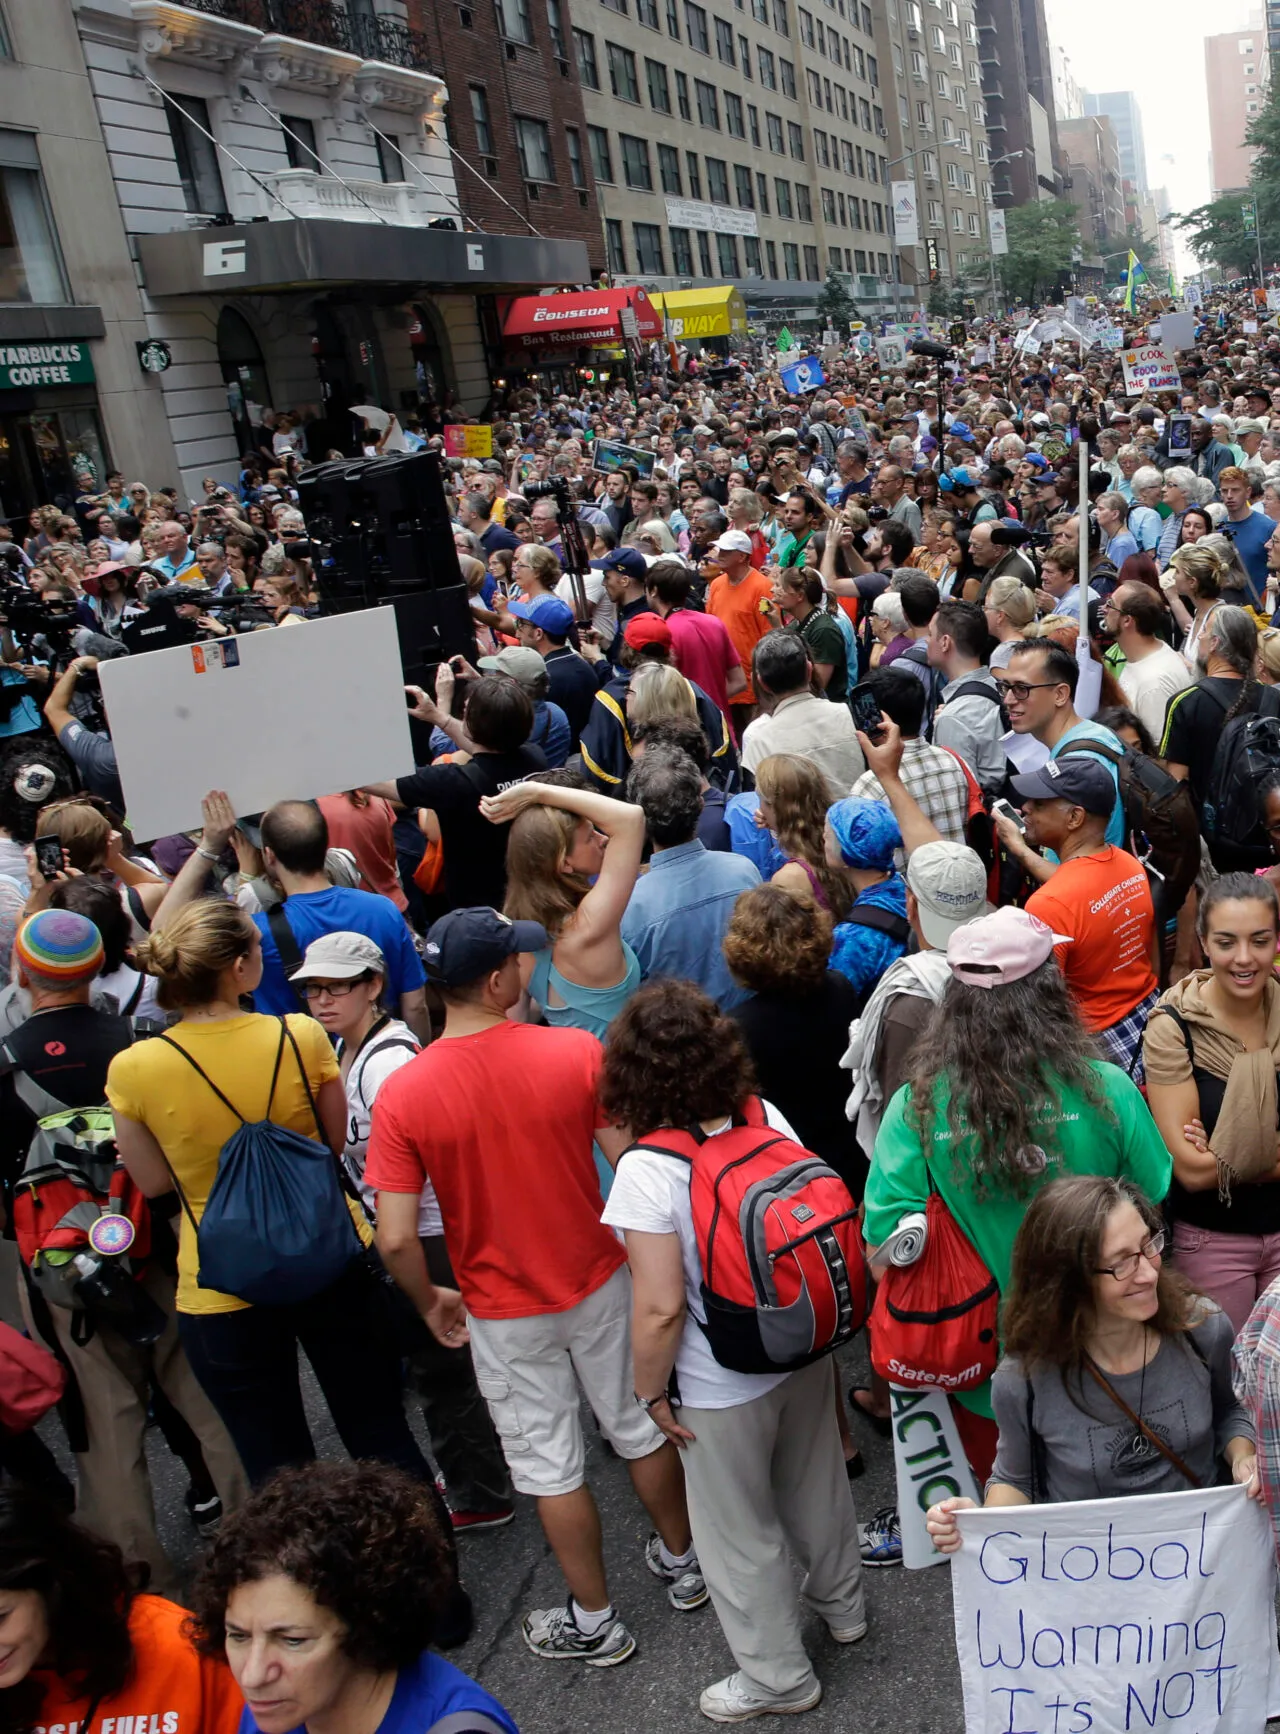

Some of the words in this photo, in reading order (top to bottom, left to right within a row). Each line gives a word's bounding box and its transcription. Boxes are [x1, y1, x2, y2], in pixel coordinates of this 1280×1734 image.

[203, 239, 246, 276] 6
[466, 243, 484, 271] 6
[927, 239, 938, 270] PARK
[533, 307, 609, 322] COLISEUM
[669, 313, 724, 336] BWAY
[522, 334, 545, 346] Bar
[550, 327, 616, 343] Restaurant
[0, 345, 82, 366] TARBUCKS
[1140, 350, 1168, 361] COOK
[8, 365, 71, 386] COFFEE
[1128, 379, 1144, 388] THE
[1148, 376, 1179, 387] PLANET
[1133, 364, 1158, 378] FOOD
[1161, 364, 1174, 372] NOT
[140, 624, 167, 636] SHURE
[1091, 884, 1122, 914] COLLEGIATE
[889, 1388, 961, 1514] ACTIO
[979, 1511, 1215, 1585] Global
[976, 1608, 1227, 1678] Warming
[1126, 1664, 1238, 1730] NOT
[101, 1711, 179, 1734] FUELS
